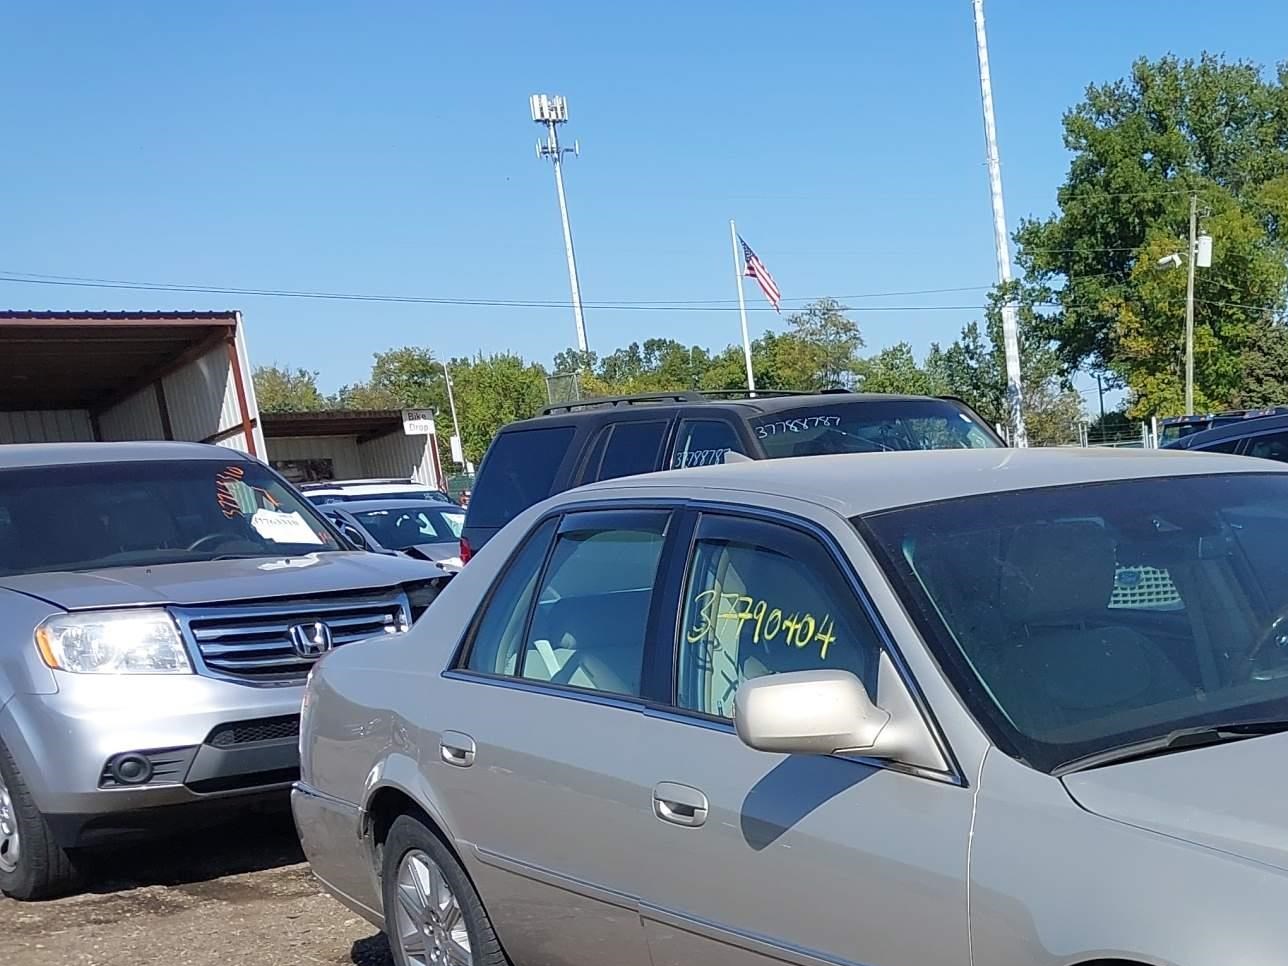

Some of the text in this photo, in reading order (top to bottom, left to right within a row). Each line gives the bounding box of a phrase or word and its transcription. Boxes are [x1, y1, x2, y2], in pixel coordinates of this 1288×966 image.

[407, 412, 427, 421] Bike
[409, 423, 429, 433] Drop
[755, 416, 841, 439] 37788787
[674, 448, 732, 468] 378878
[687, 589, 837, 660] 37790404
